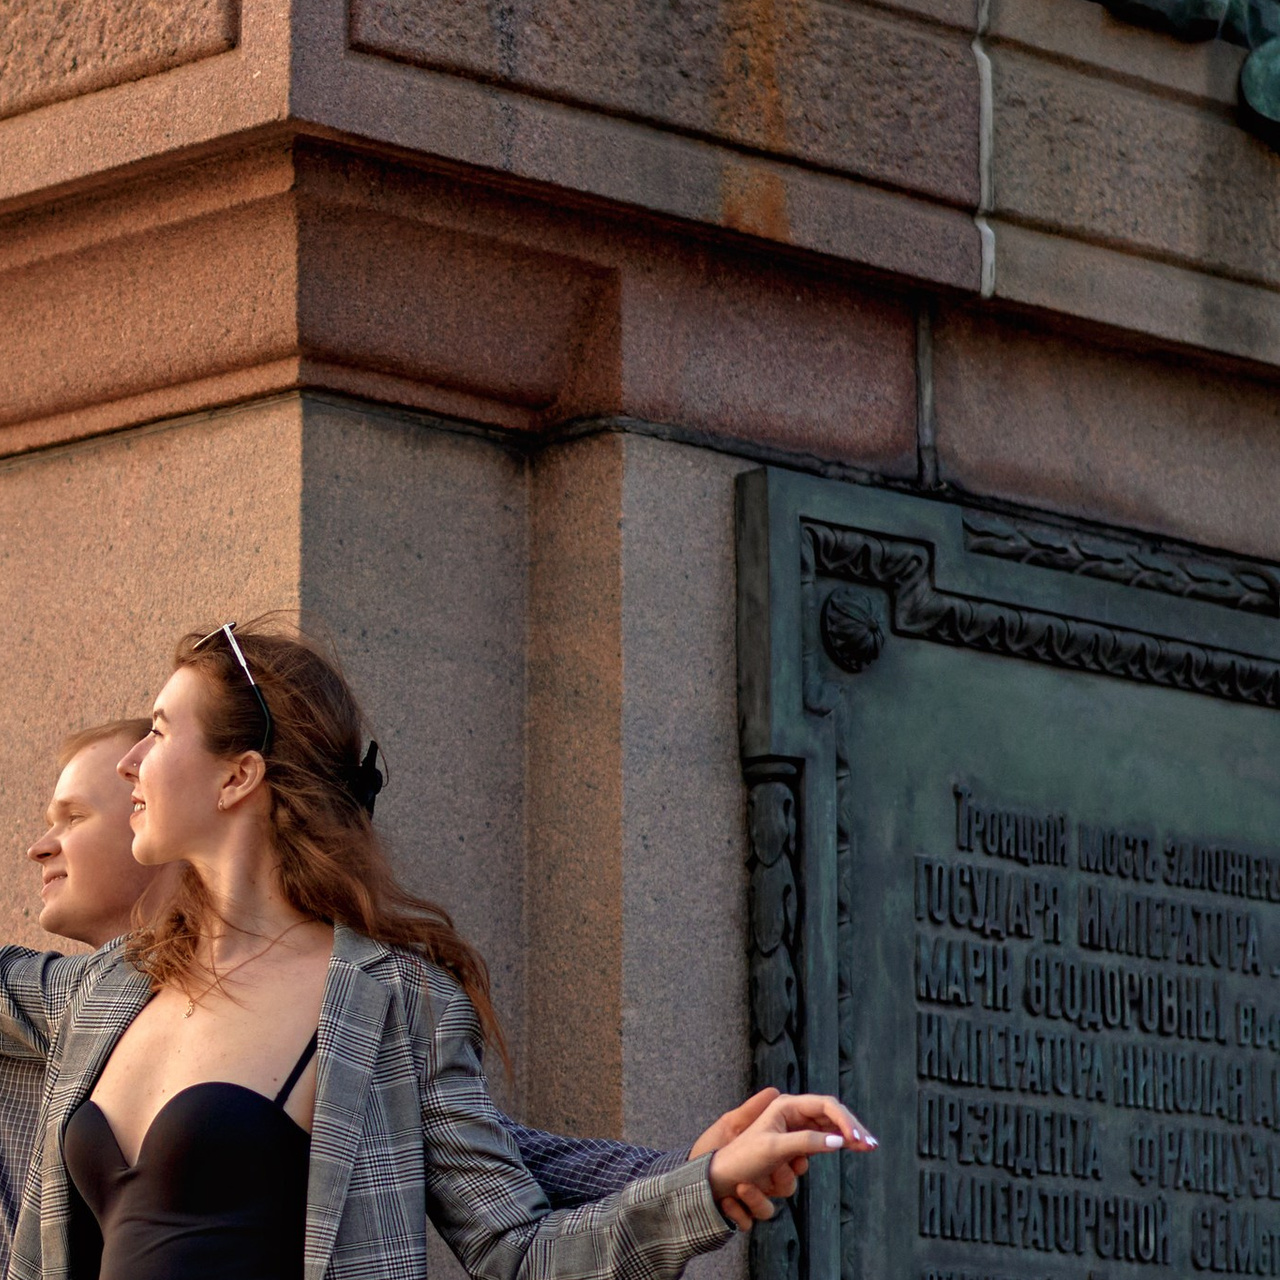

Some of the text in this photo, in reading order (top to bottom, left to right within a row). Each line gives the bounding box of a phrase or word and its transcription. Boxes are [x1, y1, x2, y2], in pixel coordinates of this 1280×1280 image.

[915, 854, 1262, 977] ГОСУДАРЯ ИМПЕРАТОРА
[916, 935, 1011, 1012] МАРІИ
[916, 1012, 1106, 1102] ИМПЕРАТОРА
[1112, 1042, 1247, 1125] НИКОЛАЯ
[917, 1089, 1101, 1180] ПРЕЗИДЕНТА
[918, 1168, 1173, 1266] ИМПЕРАТОРСКОЙ
